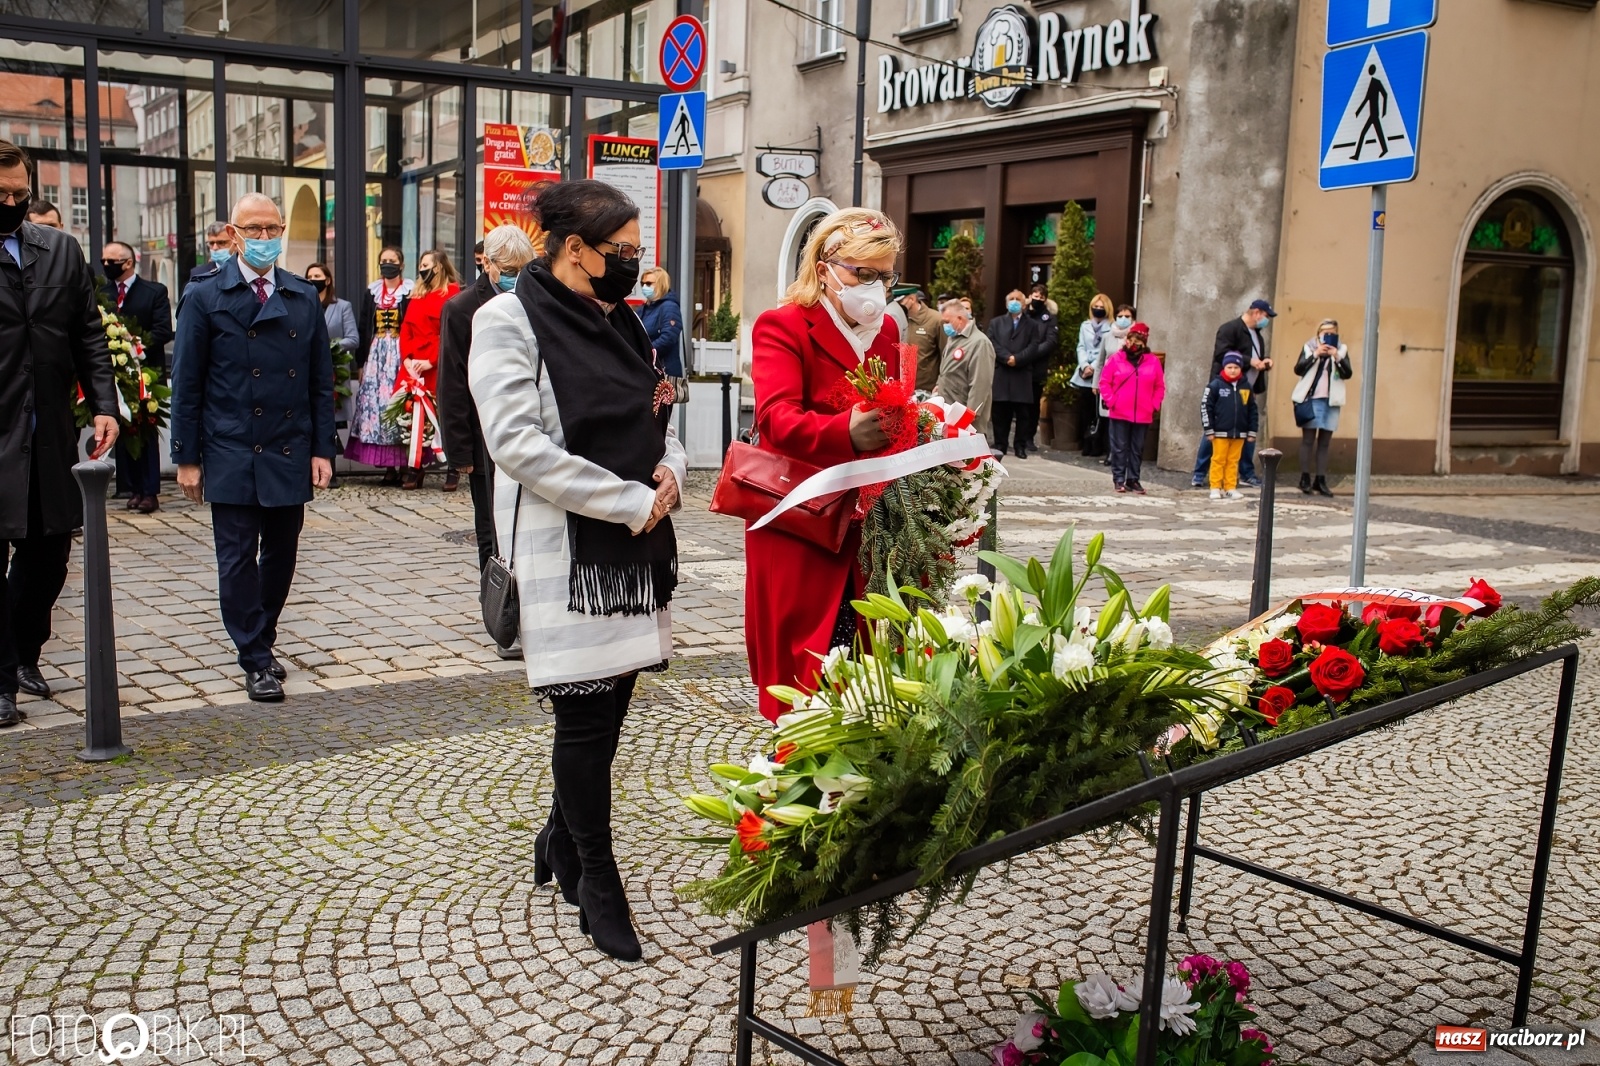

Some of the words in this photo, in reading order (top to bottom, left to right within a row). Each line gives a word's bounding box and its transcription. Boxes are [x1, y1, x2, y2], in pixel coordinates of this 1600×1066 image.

[877, 53, 971, 113] Browar
[1037, 0, 1152, 89] Rynek
[486, 125, 501, 135] Pizza
[486, 137, 505, 150] Druga
[505, 139, 521, 151] pizza
[602, 142, 650, 158] LUNCH
[494, 150, 516, 162] gratis!
[773, 157, 805, 171] BUTIK
[489, 202, 497, 210] W
